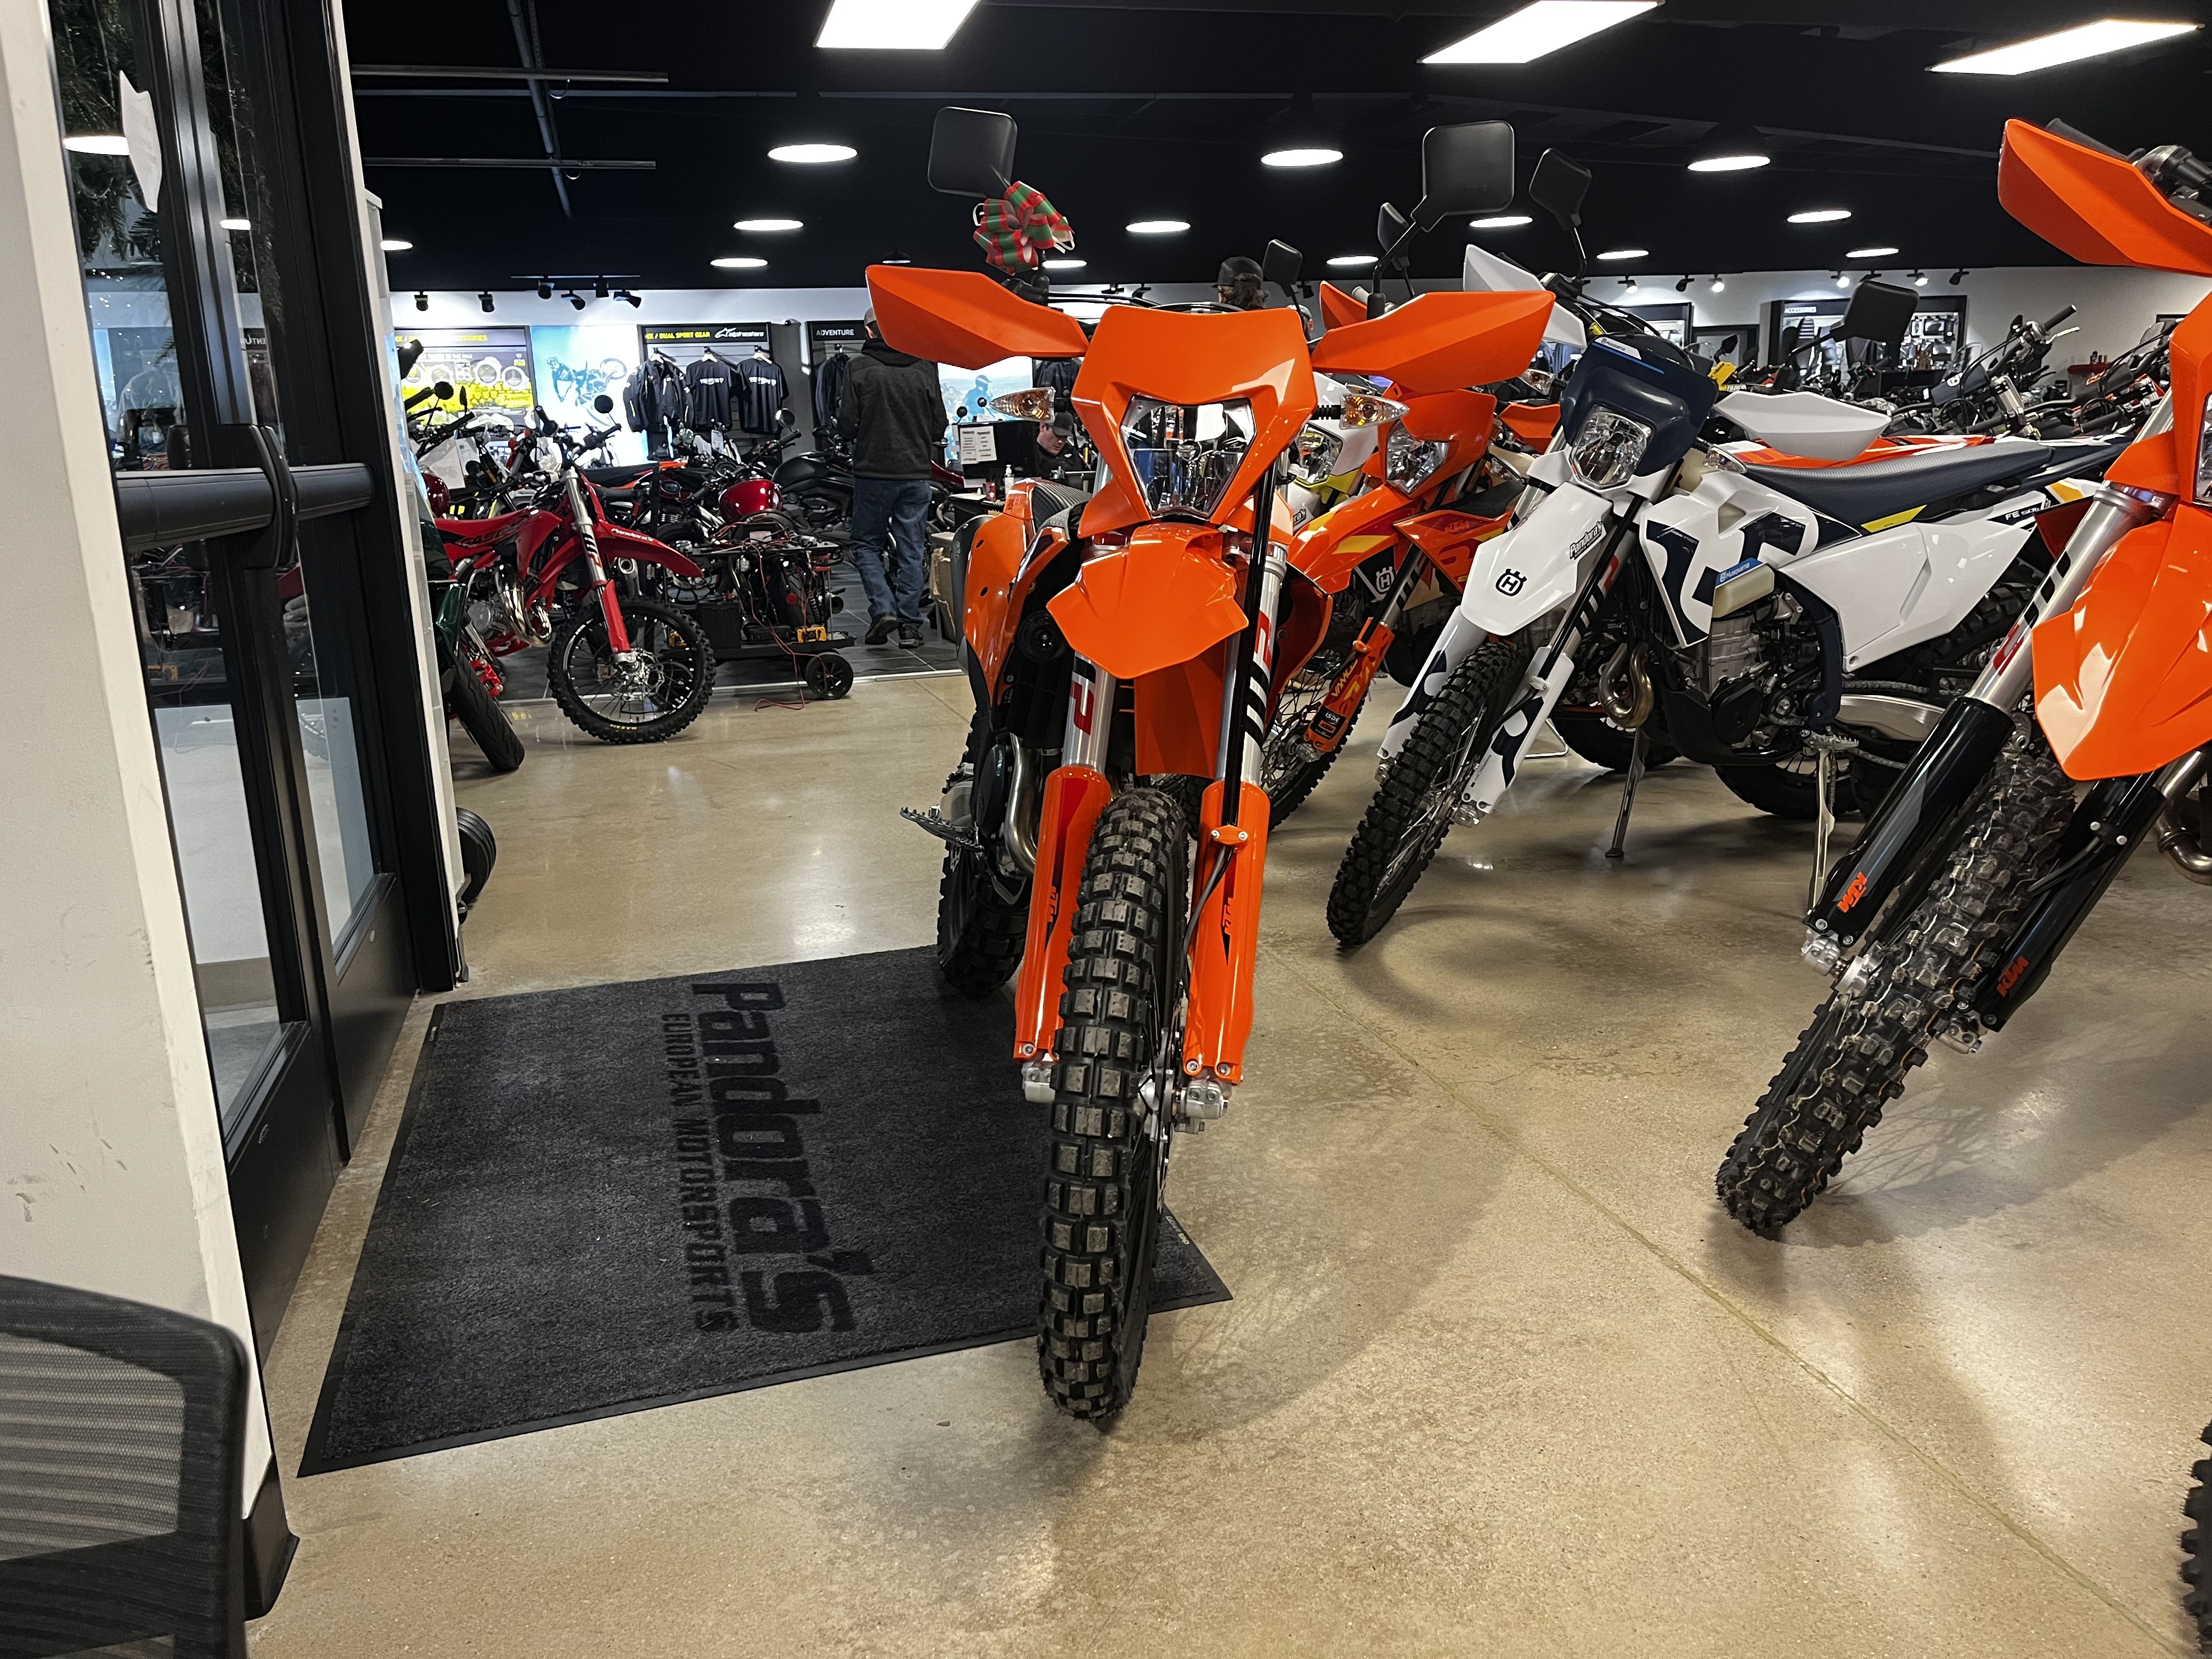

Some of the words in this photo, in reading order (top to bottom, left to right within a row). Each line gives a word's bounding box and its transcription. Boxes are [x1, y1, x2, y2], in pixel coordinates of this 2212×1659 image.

[2005, 511, 2020, 520] FE
[1570, 521, 1602, 558] Pandora's
[1837, 871, 1867, 913] KTM
[1997, 956, 2029, 997] KTM
[663, 1013, 702, 1107] EUROPEAN
[692, 983, 875, 1333] Pandora's
[673, 1118, 739, 1332] MOTORSPORTS
